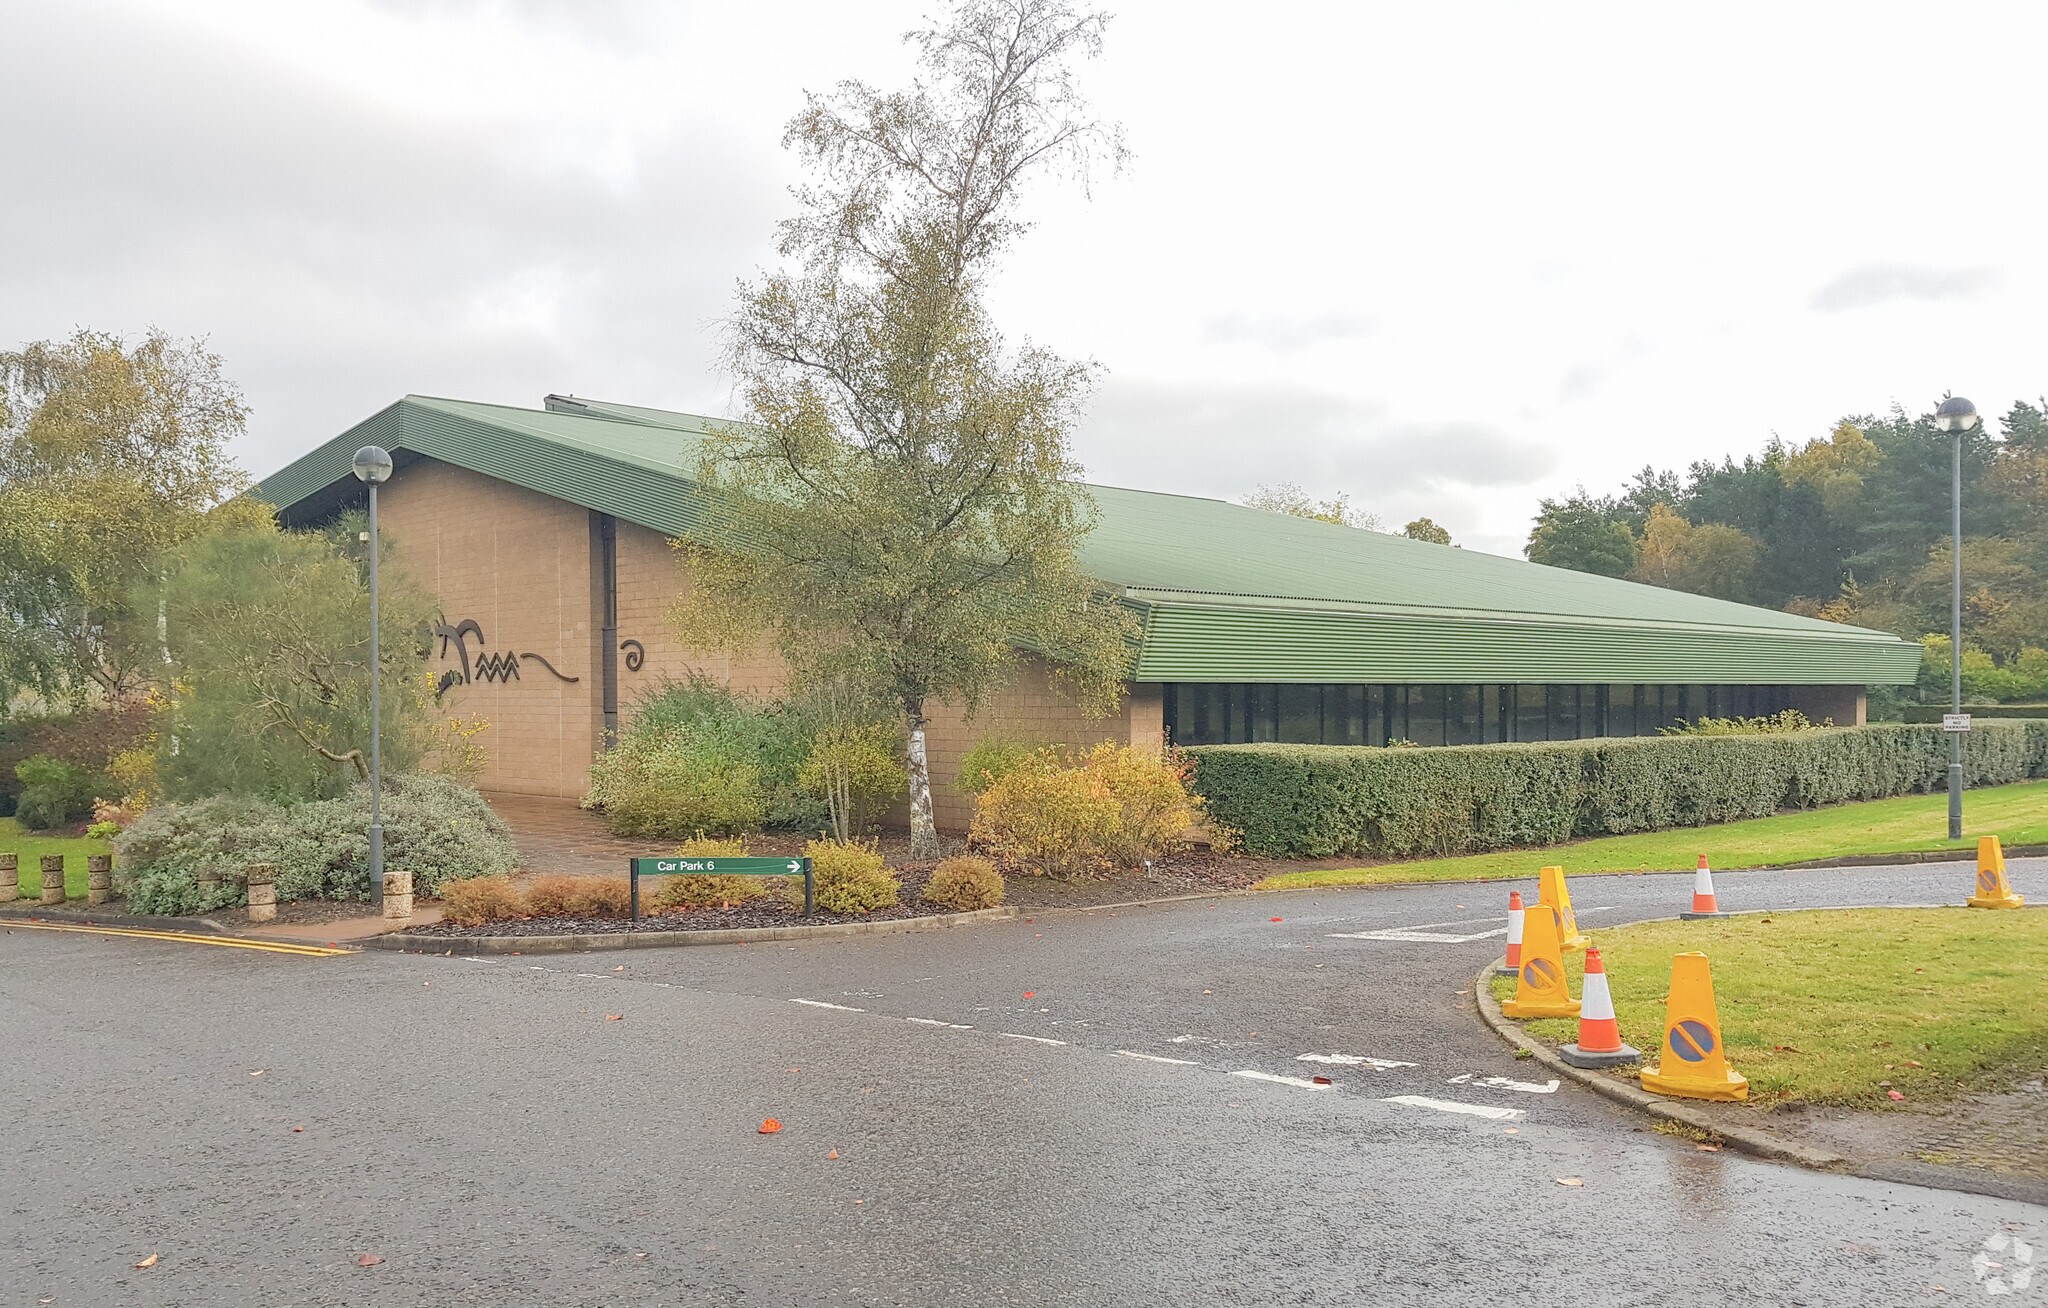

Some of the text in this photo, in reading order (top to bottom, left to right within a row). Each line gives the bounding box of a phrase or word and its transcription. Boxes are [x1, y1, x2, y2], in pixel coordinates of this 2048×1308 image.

[657, 861, 715, 871] Car Park 6
